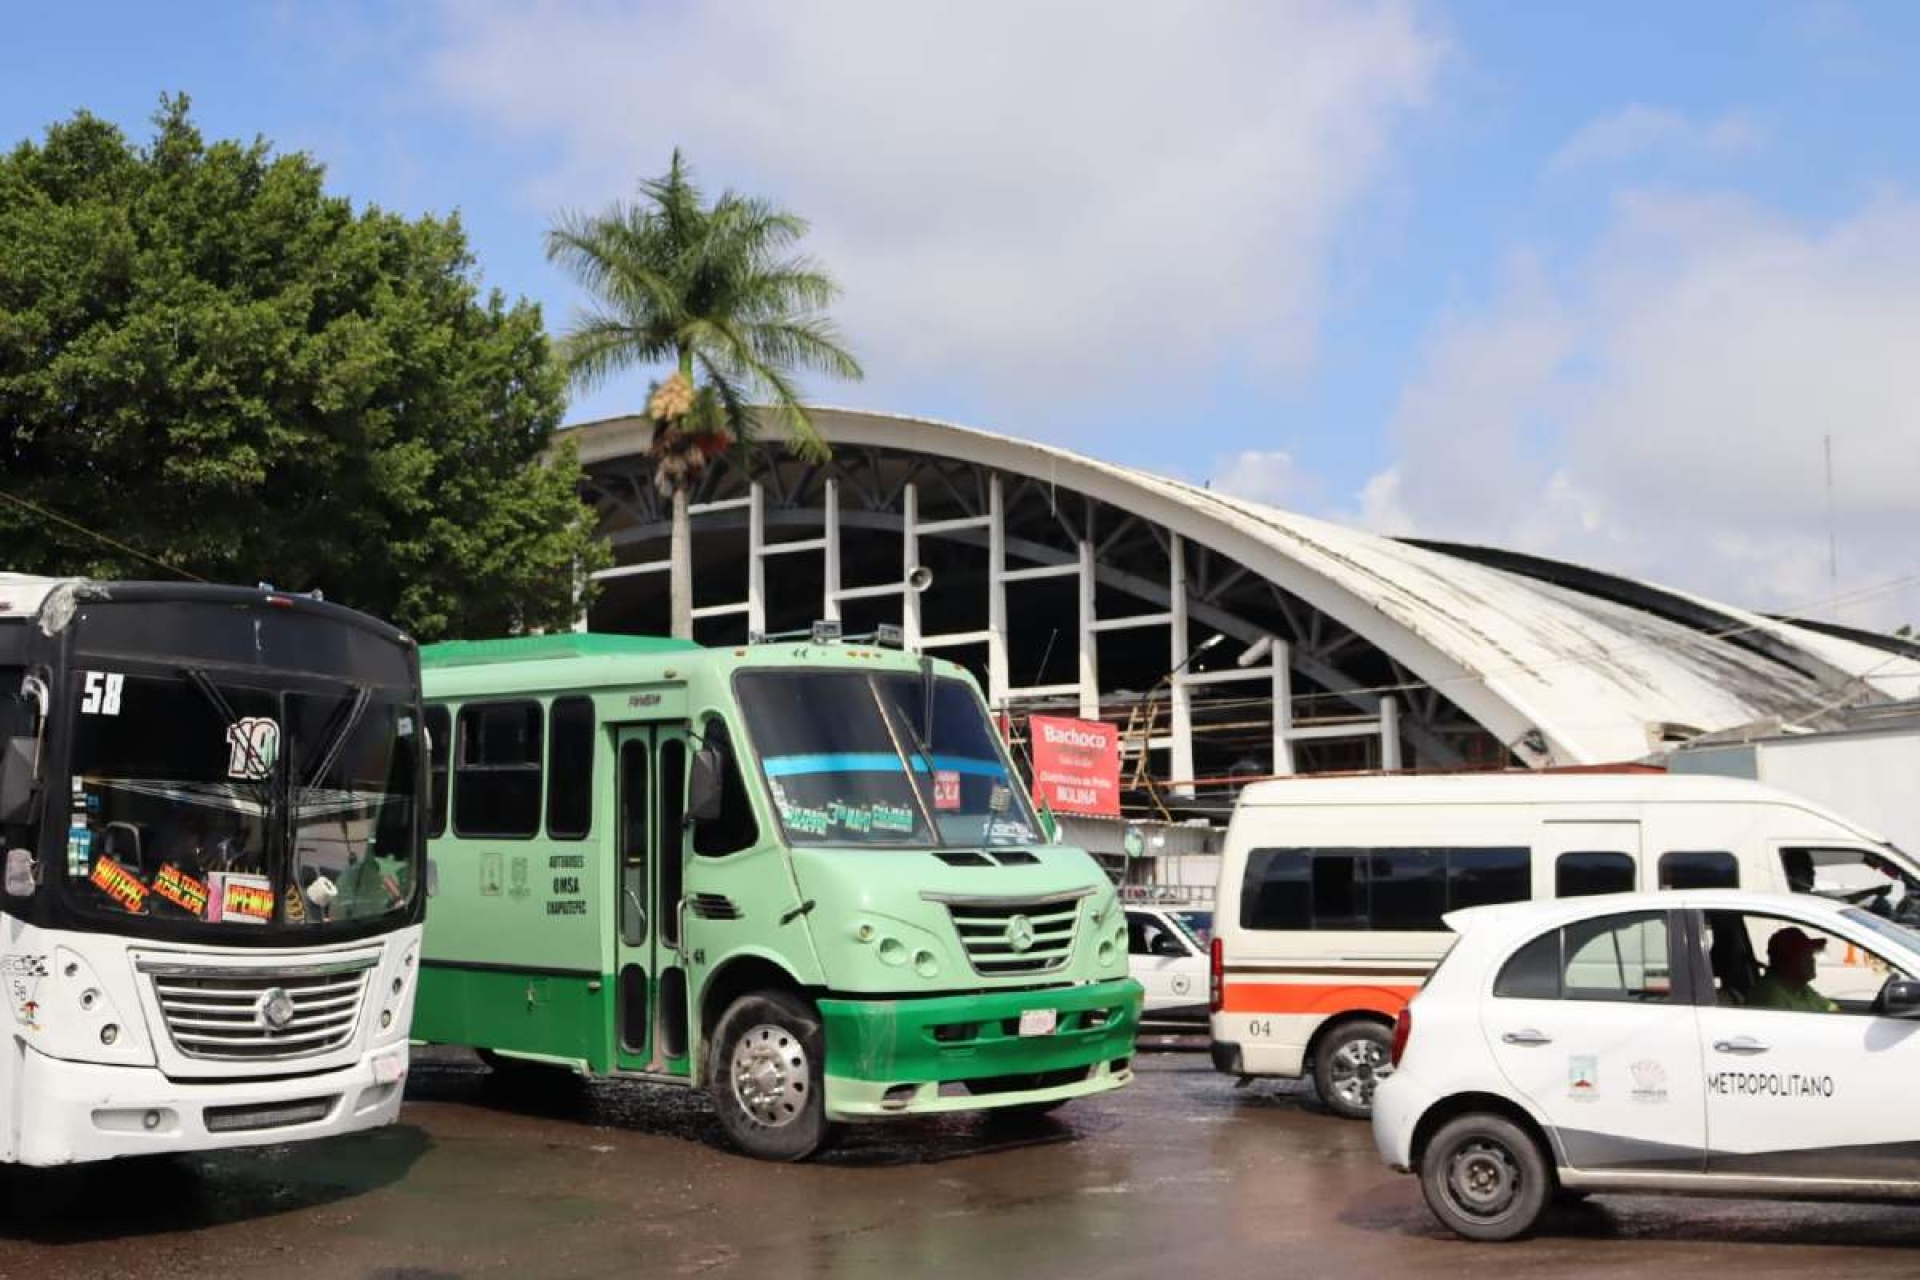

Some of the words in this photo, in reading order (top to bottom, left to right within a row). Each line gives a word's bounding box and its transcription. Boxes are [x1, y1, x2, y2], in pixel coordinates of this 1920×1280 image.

[81, 671, 124, 715] 58
[1043, 724, 1106, 748] Bachoco
[1249, 1020, 1271, 1038] 04
[1707, 1071, 1833, 1097] METROPOLITANO
